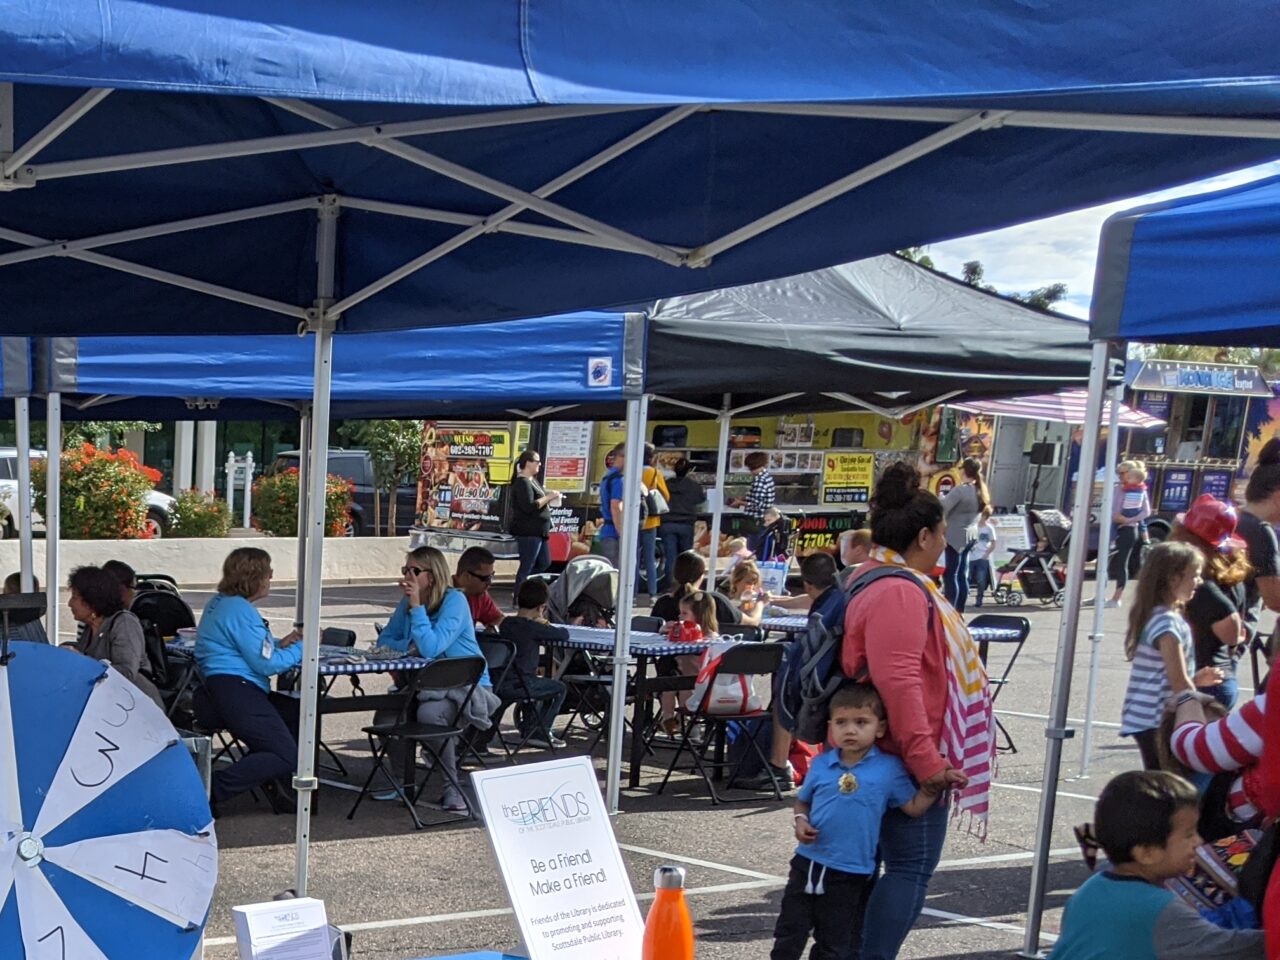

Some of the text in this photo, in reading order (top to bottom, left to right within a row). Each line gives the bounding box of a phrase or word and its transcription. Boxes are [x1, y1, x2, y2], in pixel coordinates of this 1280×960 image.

[70, 731, 120, 788] 3
[502, 791, 589, 826] the FRIENDS
[114, 852, 169, 885] 4
[530, 849, 592, 873] Be a Friend!
[529, 868, 607, 896] Make a Friend!
[531, 914, 553, 926] Friends
[553, 913, 559, 921] of
[560, 912, 570, 920] the
[570, 907, 592, 917] Library
[598, 899, 626, 911] dedicated
[550, 923, 581, 938] promoting
[581, 920, 592, 930] and
[593, 914, 624, 927] supporting
[552, 937, 583, 951] Scottsdale
[583, 932, 601, 943] Public
